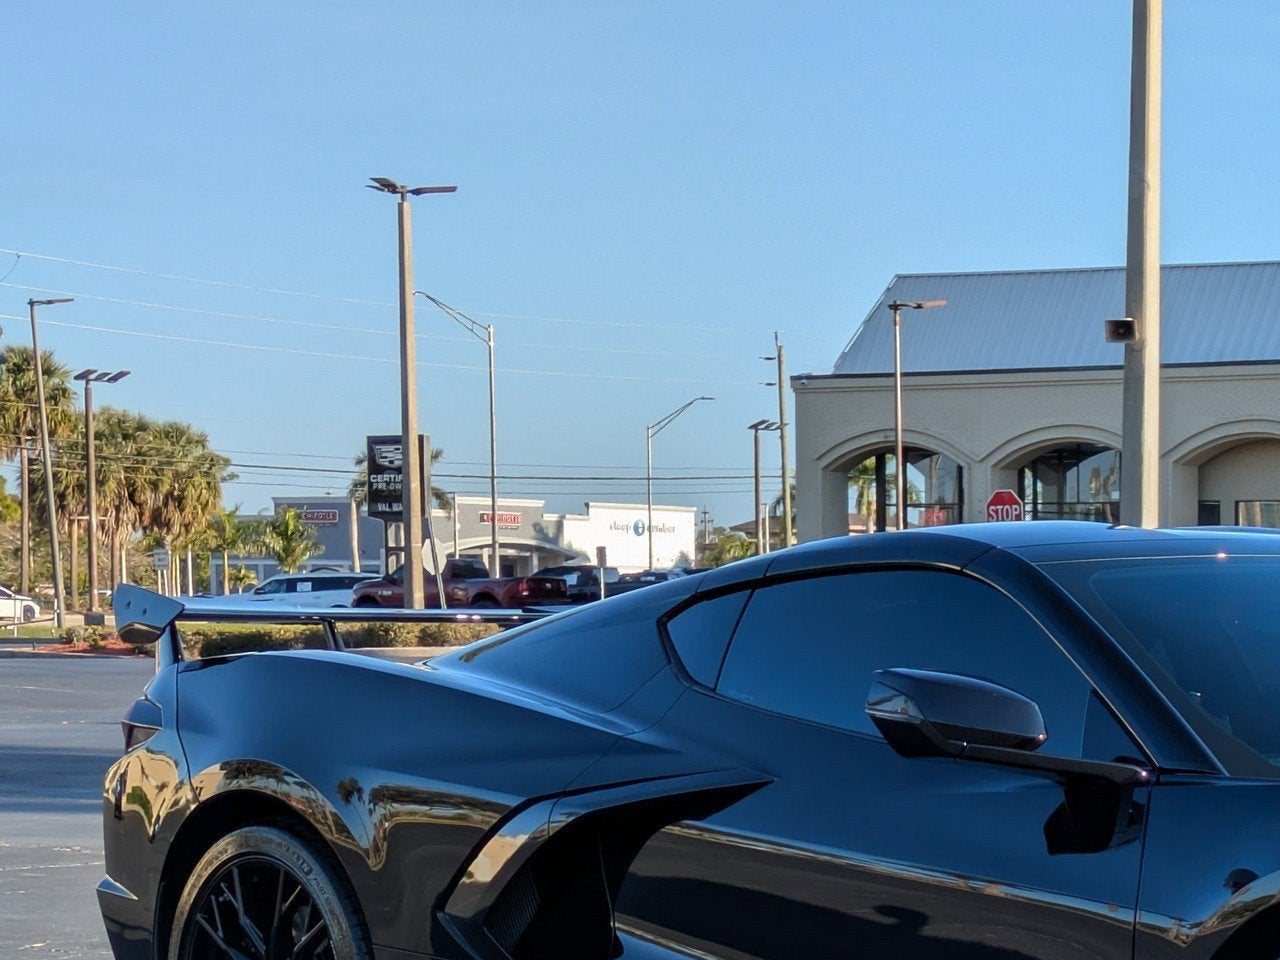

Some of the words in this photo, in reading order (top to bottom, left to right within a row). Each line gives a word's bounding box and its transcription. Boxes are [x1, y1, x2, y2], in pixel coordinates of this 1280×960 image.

[370, 474, 403, 483] CERTIF
[372, 482, 402, 490] PRE-OW
[377, 502, 391, 511] VAL
[392, 502, 403, 511] WA
[988, 504, 1020, 521] STOP
[609, 520, 631, 534] sleep
